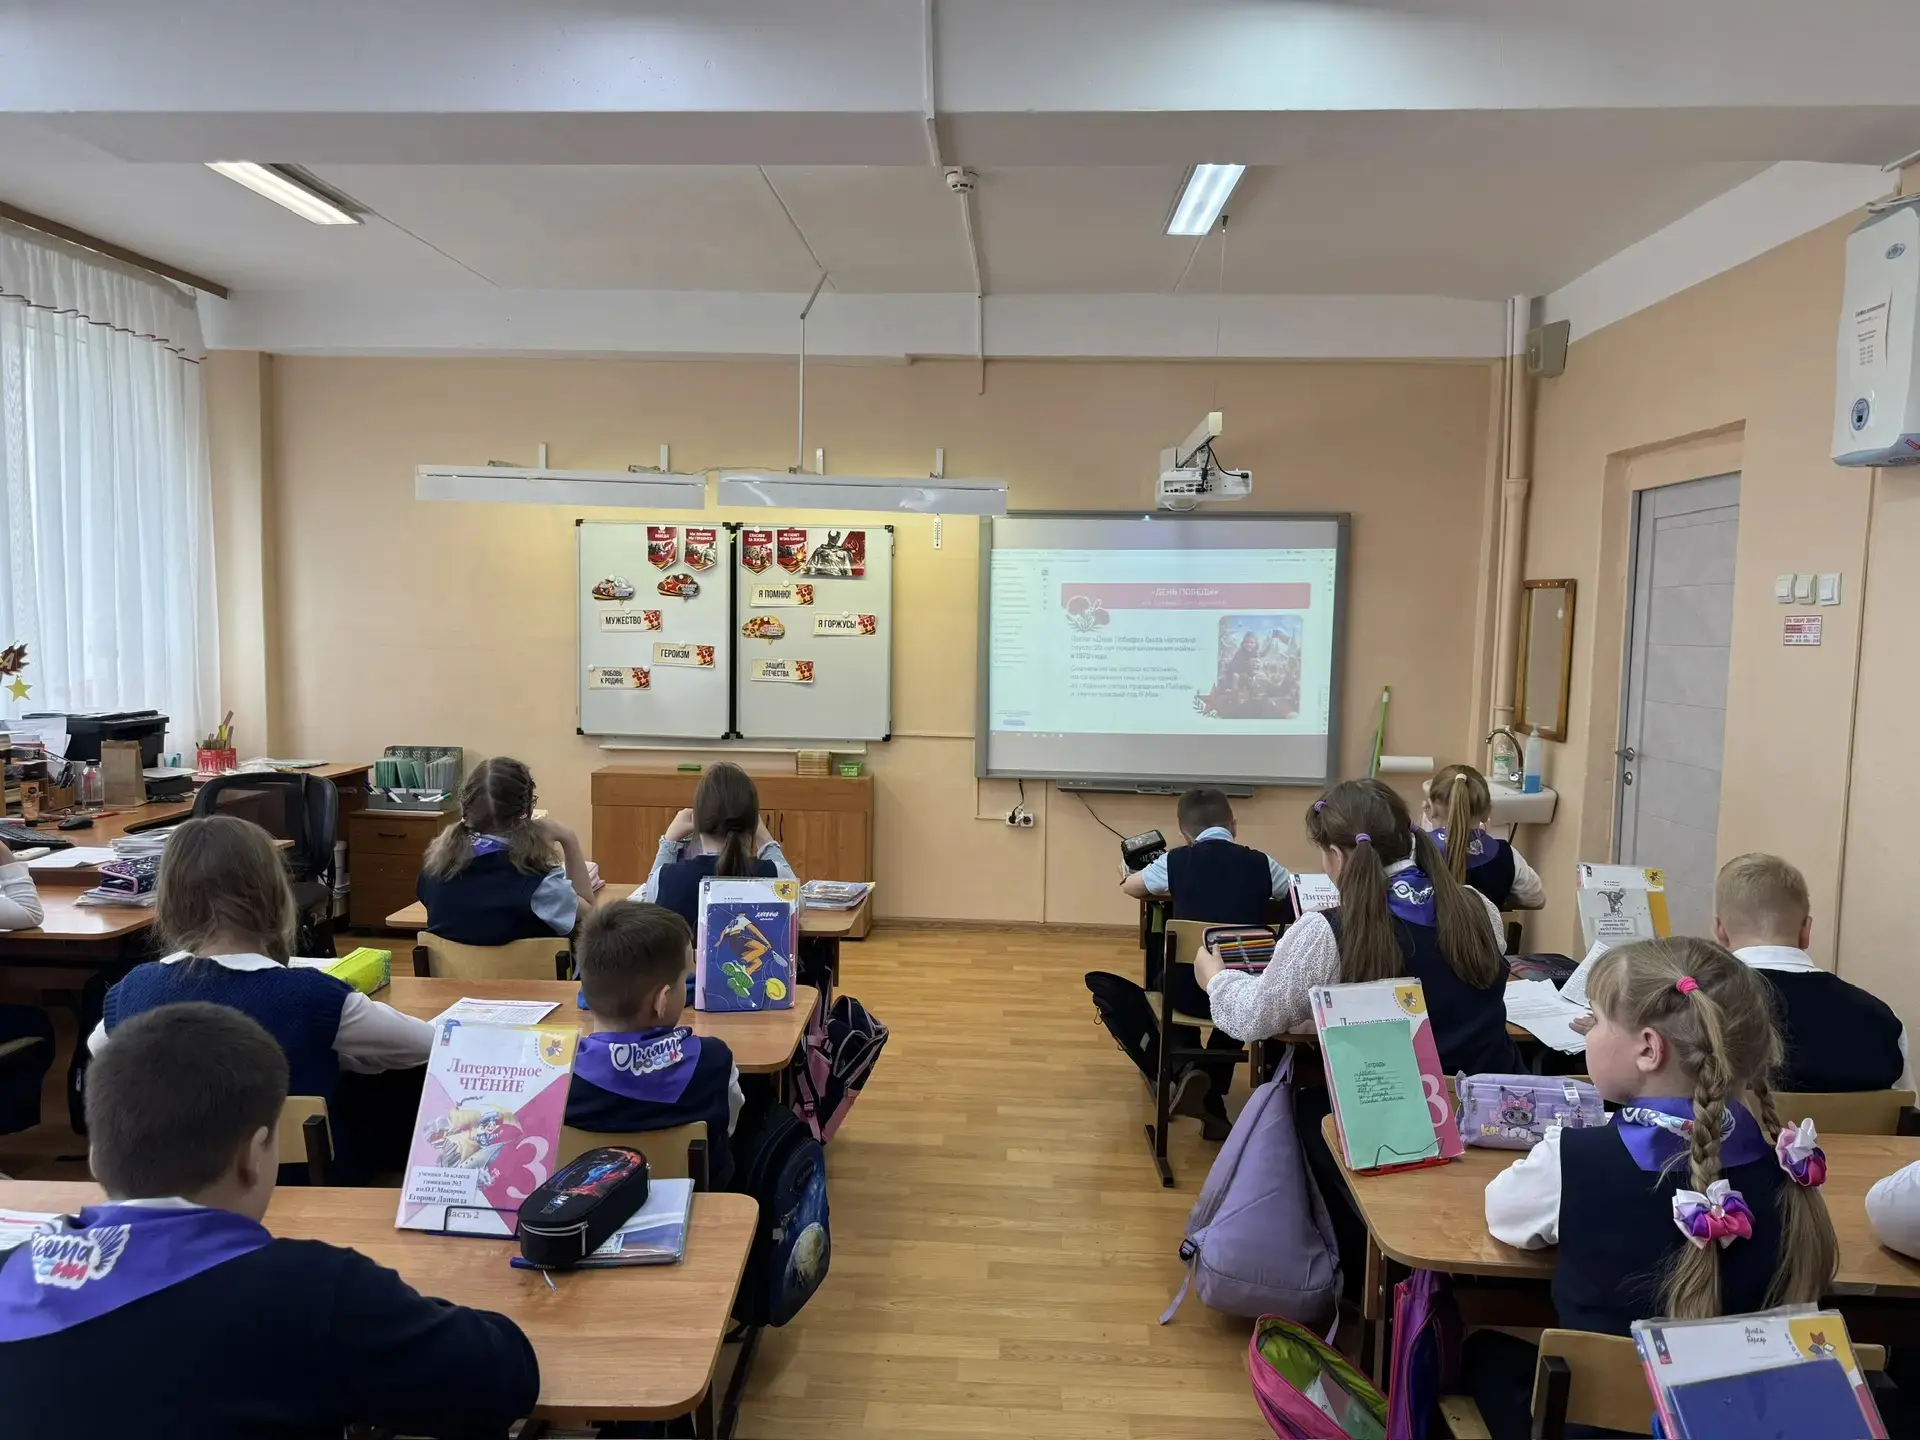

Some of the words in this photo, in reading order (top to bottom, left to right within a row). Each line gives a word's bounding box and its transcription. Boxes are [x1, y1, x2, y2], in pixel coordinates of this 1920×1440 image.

[758, 589, 763, 598] Я
[764, 589, 791, 599] ПОМНЮ!
[605, 616, 642, 625] МУЖЕСТВО
[818, 619, 823, 628] Я
[824, 619, 856, 629] ГОРЖУСЬ!
[660, 649, 690, 659] ГЕРОИЗМ
[605, 677, 624, 685] РОДИНЕ
[1302, 893, 1341, 902] Литерат
[634, 1050, 679, 1071] РОССИ
[447, 1057, 542, 1079] Литературное
[460, 1077, 525, 1093] ЧТЕНИЕ
[506, 1136, 550, 1199] 3
[409, 1194, 436, 1203] Егорова
[474, 1211, 479, 1219] 2
